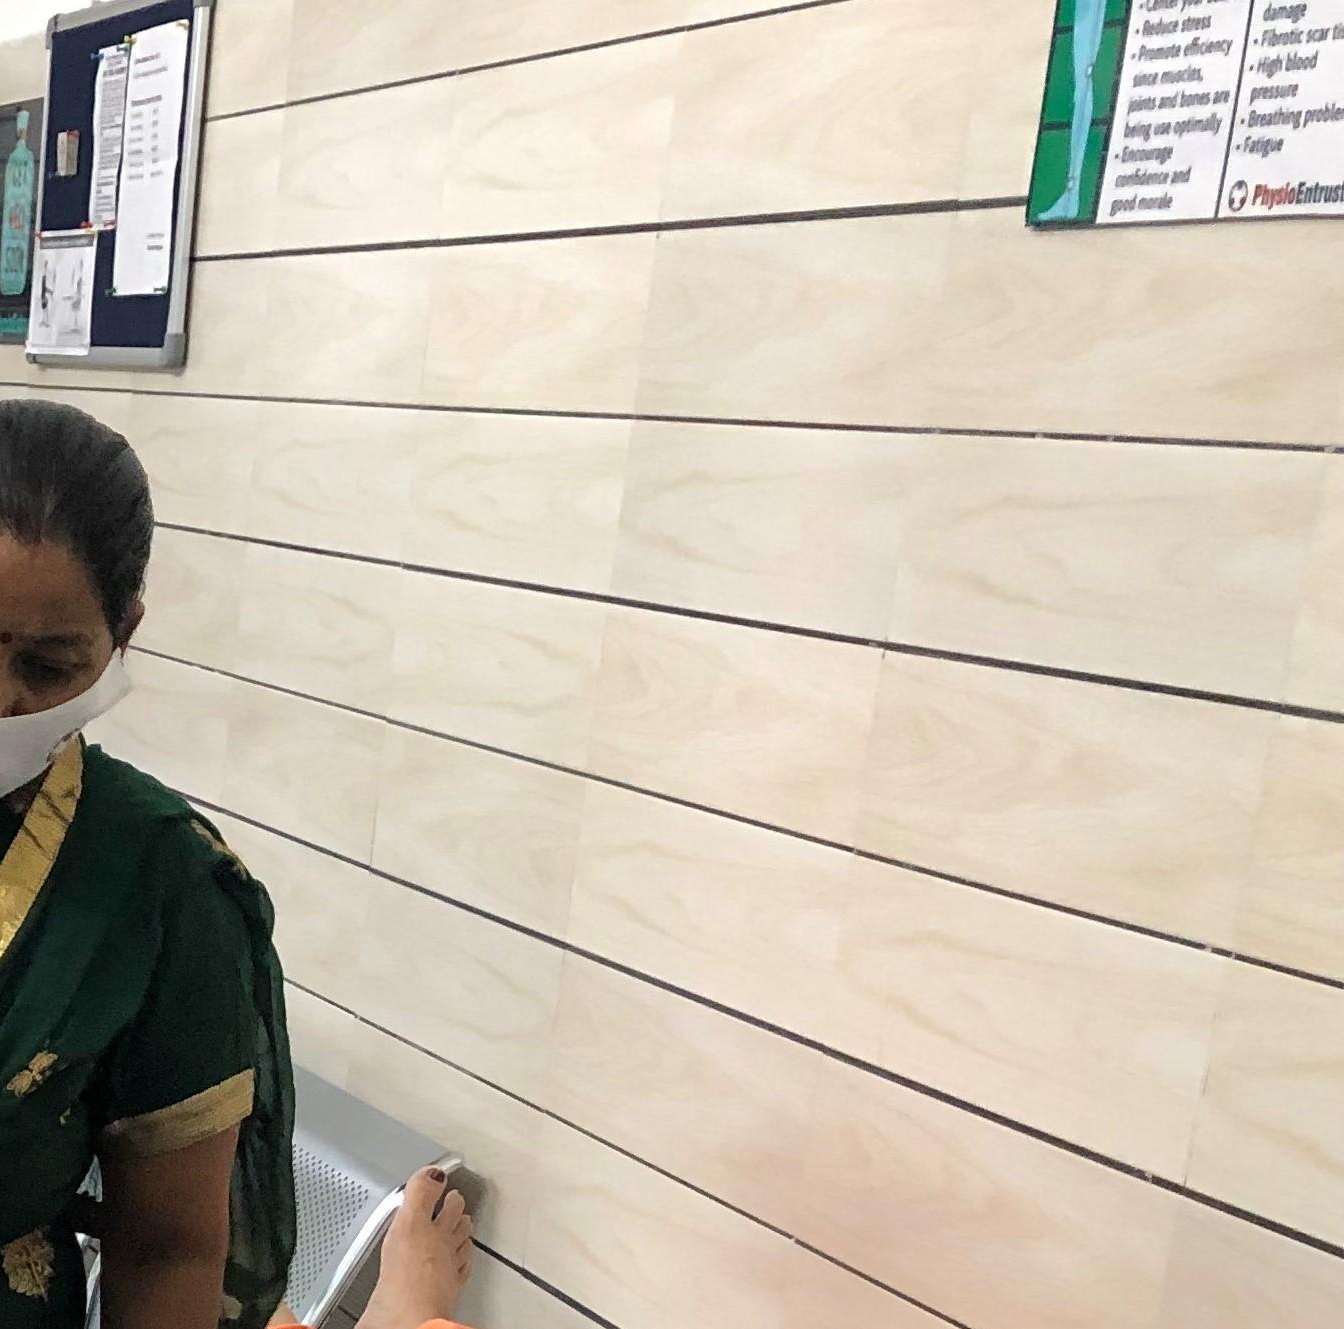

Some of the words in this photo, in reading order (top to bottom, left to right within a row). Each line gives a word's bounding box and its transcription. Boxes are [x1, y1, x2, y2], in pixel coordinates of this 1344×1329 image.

[1263, 3, 1307, 23] damage
[1142, 18, 1179, 36] Reduce
[1181, 16, 1211, 32] stress
[1261, 28, 1304, 46] Fibrotic
[1306, 28, 1330, 43] scar
[1139, 44, 1181, 60] Promote
[1183, 37, 1233, 56] efficiency
[1257, 54, 1283, 79] High
[1285, 50, 1319, 72] blood
[1158, 91, 1180, 109] and
[1180, 91, 1210, 107] bones
[1213, 90, 1230, 104] are
[1249, 84, 1299, 106] pressure
[1124, 122, 1152, 142] being
[1173, 113, 1222, 138] optimally
[1248, 106, 1302, 130] Breathing
[1121, 146, 1173, 165] Encourage
[1243, 135, 1284, 158] Fatigue
[1115, 168, 1169, 187] confidence
[1171, 166, 1192, 184] and
[1109, 194, 1137, 217] good
